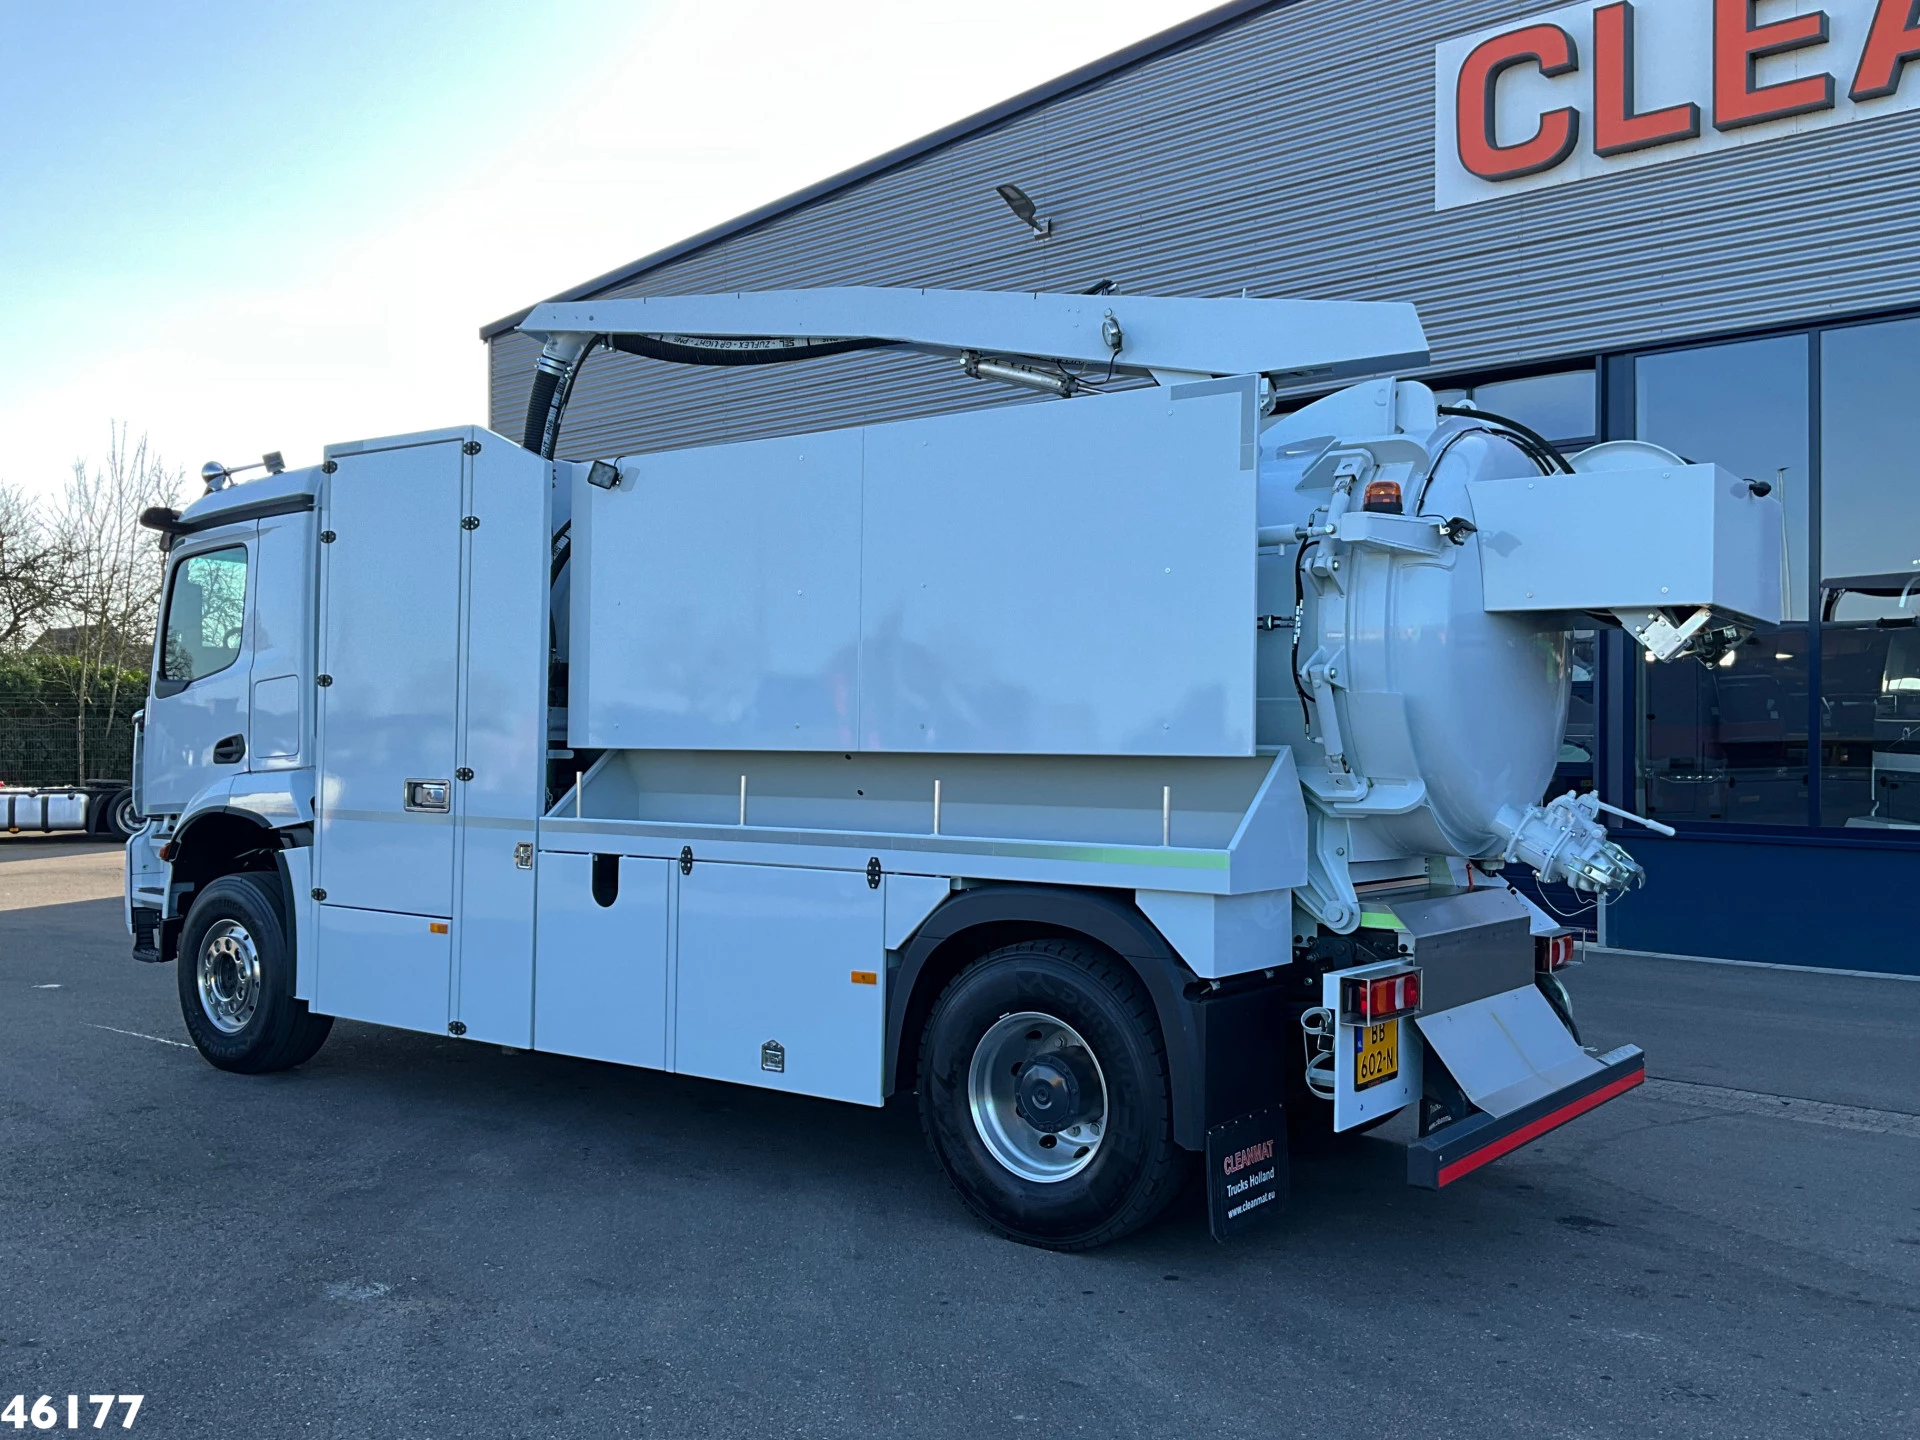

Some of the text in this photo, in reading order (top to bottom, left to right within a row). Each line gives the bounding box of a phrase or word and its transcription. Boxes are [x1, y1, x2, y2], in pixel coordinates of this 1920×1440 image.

[673, 336, 690, 345] PNS
[738, 340, 771, 349] ZUFLEX
[1371, 1022, 1385, 1044] BB
[1361, 1047, 1393, 1078] 602-N
[1223, 1139, 1274, 1176] CLEANMAT
[1226, 1166, 1275, 1198] Trucks Holland
[1228, 1190, 1276, 1219] www.cleanmat.eu
